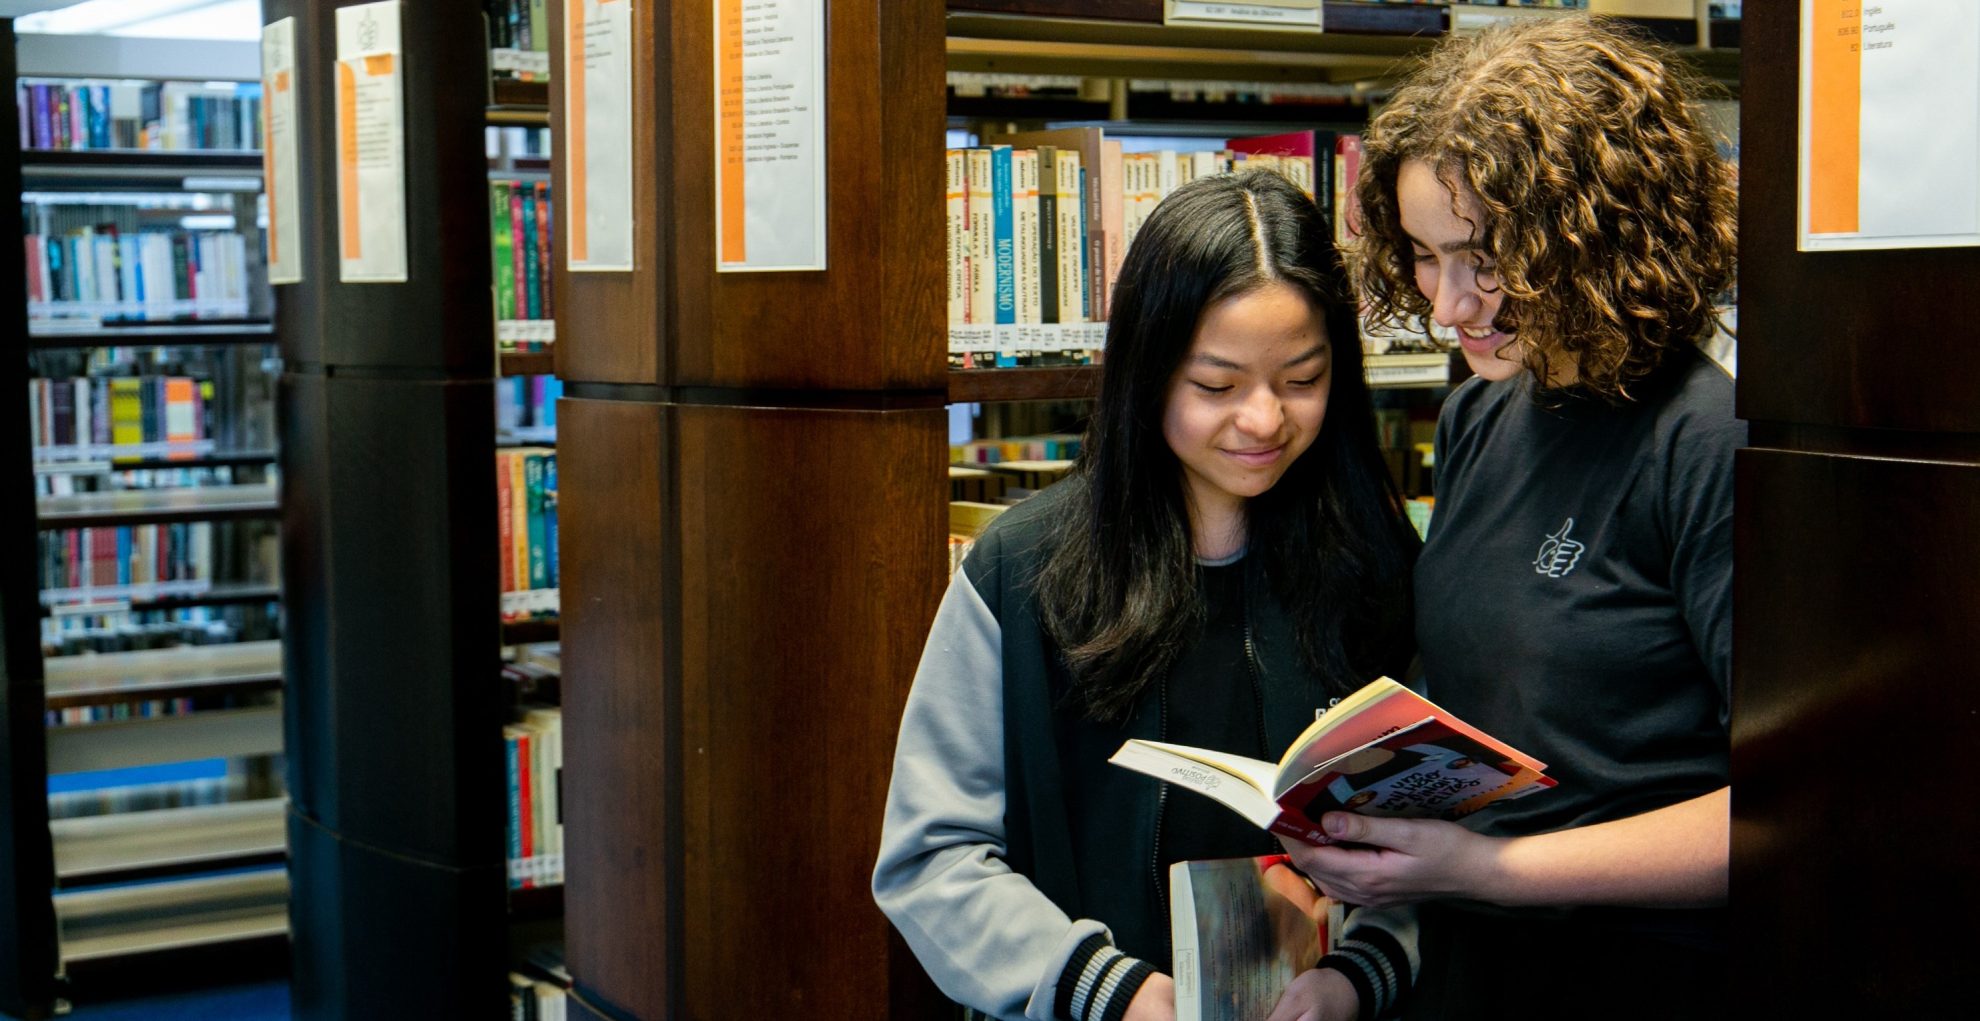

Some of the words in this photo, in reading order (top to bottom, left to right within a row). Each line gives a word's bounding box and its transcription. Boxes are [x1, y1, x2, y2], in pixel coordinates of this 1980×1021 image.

[1864, 22, 1894, 33] Português
[1864, 41, 1893, 50] Literatura
[998, 239, 1013, 311] MODERNISMO
[1170, 767, 1207, 781] POSITIVO
